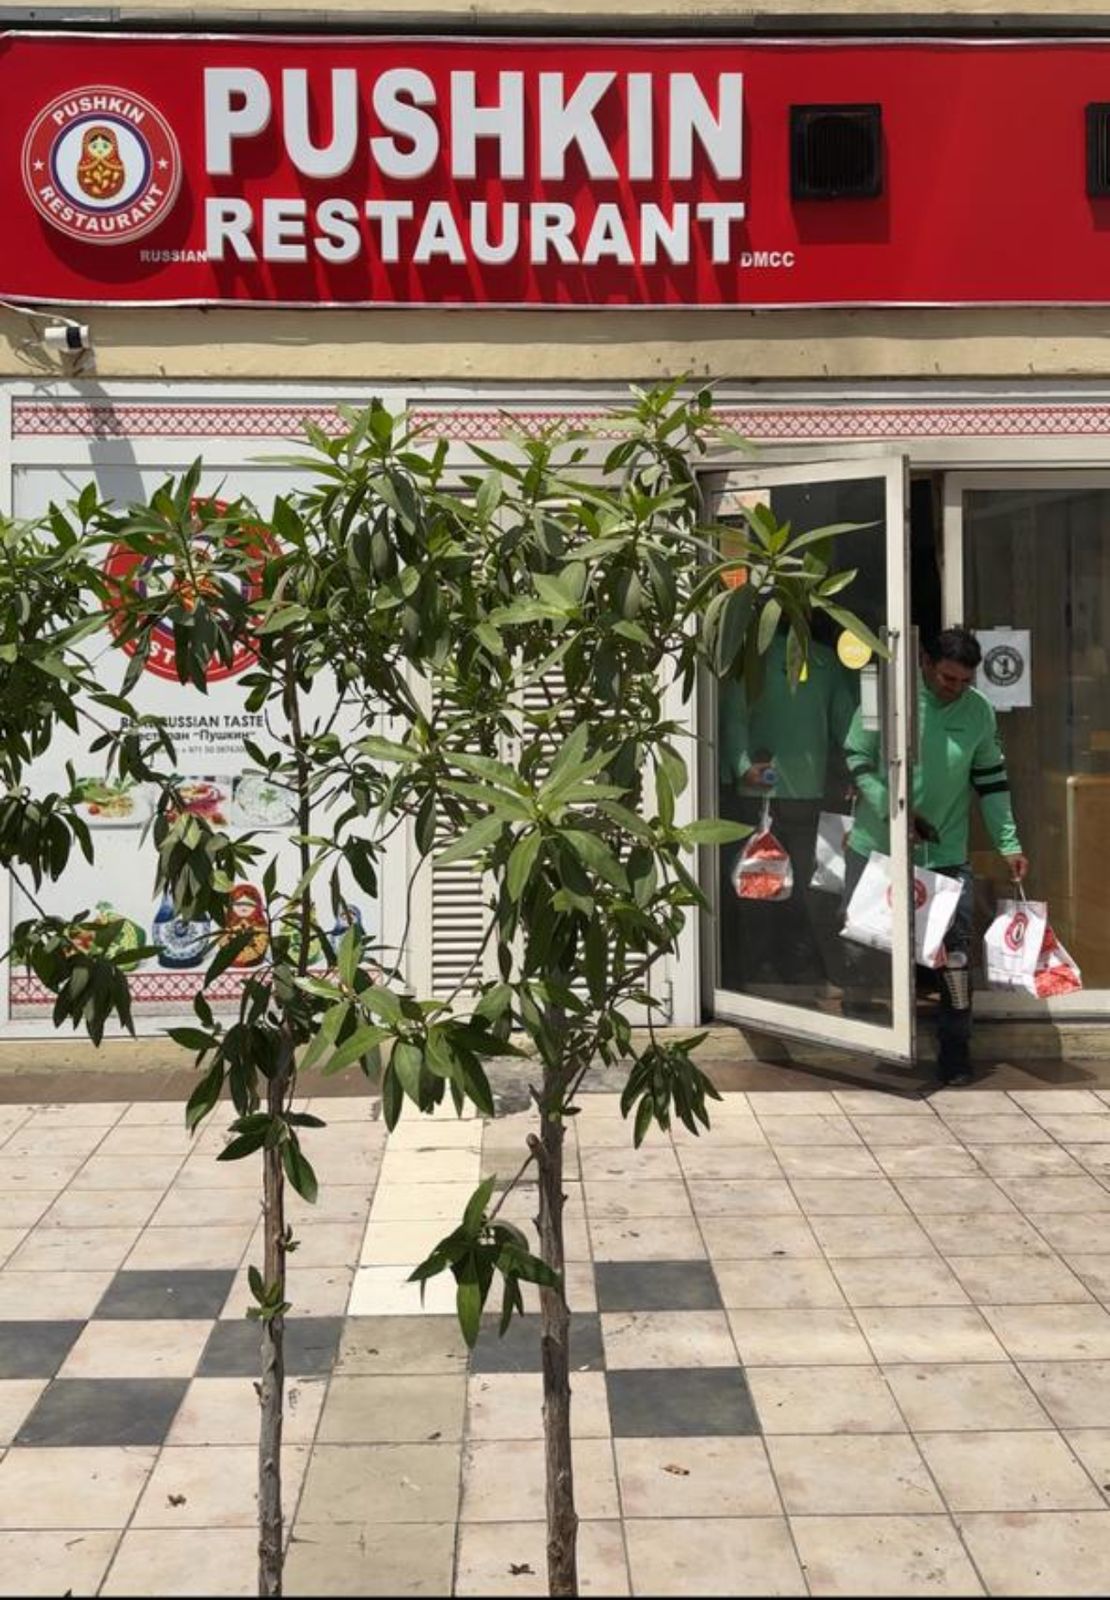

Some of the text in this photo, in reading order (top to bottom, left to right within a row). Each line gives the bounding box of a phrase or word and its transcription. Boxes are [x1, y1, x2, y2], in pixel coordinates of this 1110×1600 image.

[52, 96, 146, 125] PUSHKIN
[204, 67, 743, 180] PUSHKIN
[39, 183, 164, 232] RESTAURANT
[205, 197, 744, 264] RESTAURANT
[140, 249, 207, 263] RUSSIAN
[740, 251, 794, 267] DMCC
[223, 715, 263, 728] TASTE
